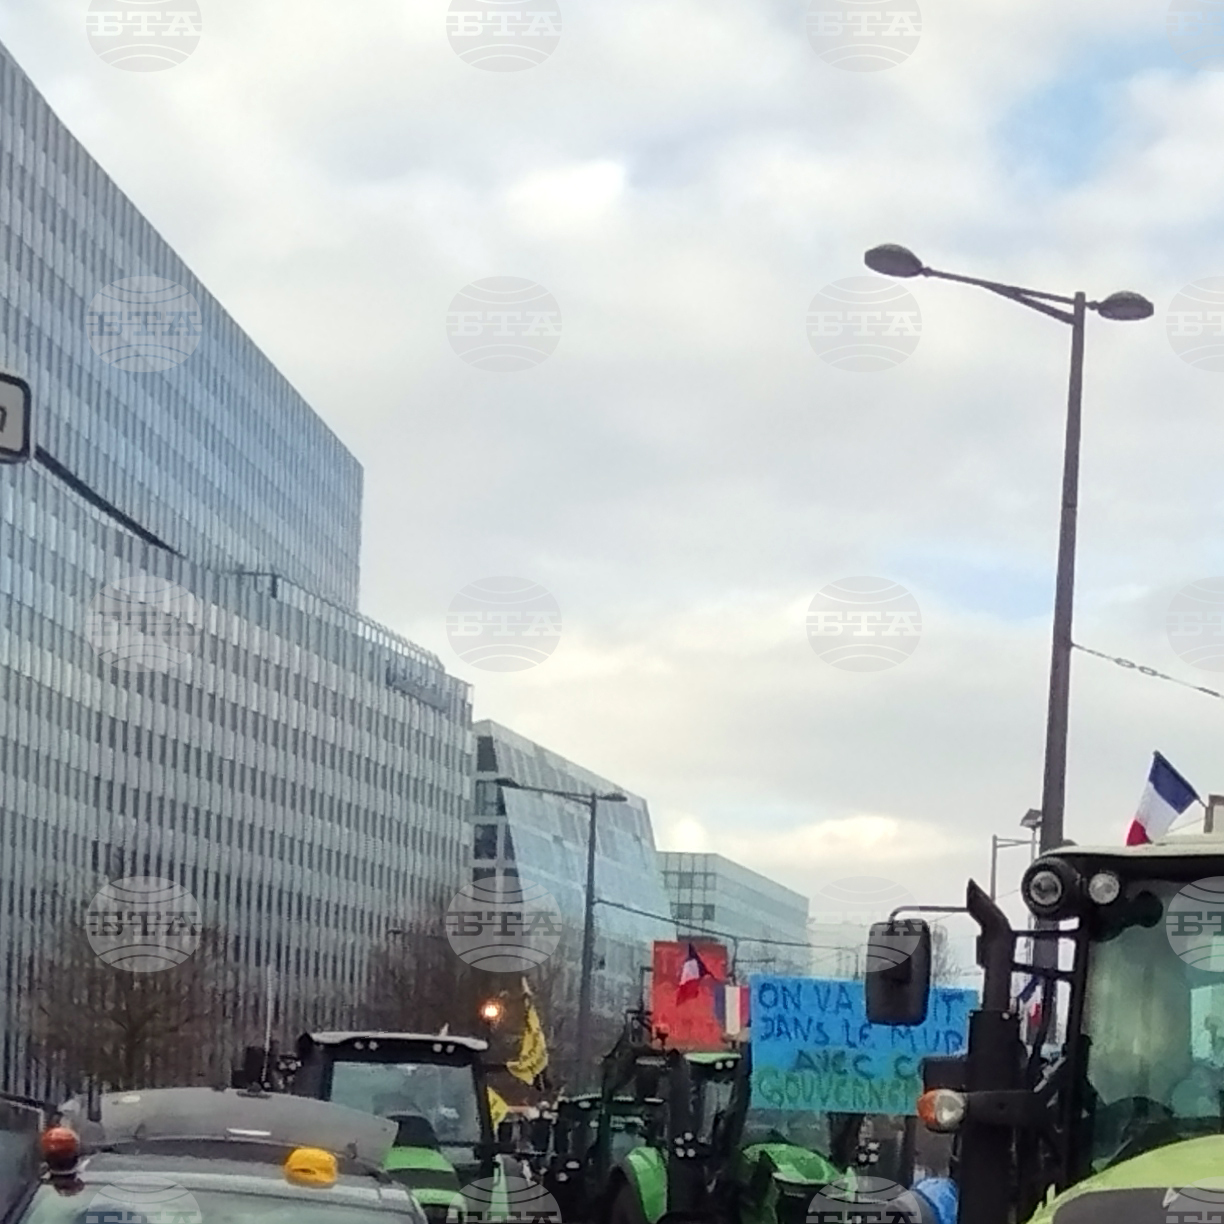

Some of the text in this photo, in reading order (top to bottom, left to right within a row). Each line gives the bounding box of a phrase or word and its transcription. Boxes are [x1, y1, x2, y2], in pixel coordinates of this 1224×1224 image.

[758, 982, 803, 1012] ON
[813, 983, 854, 1015] VA
[841, 1018, 876, 1049] LE
[793, 1049, 876, 1079] AVEC
